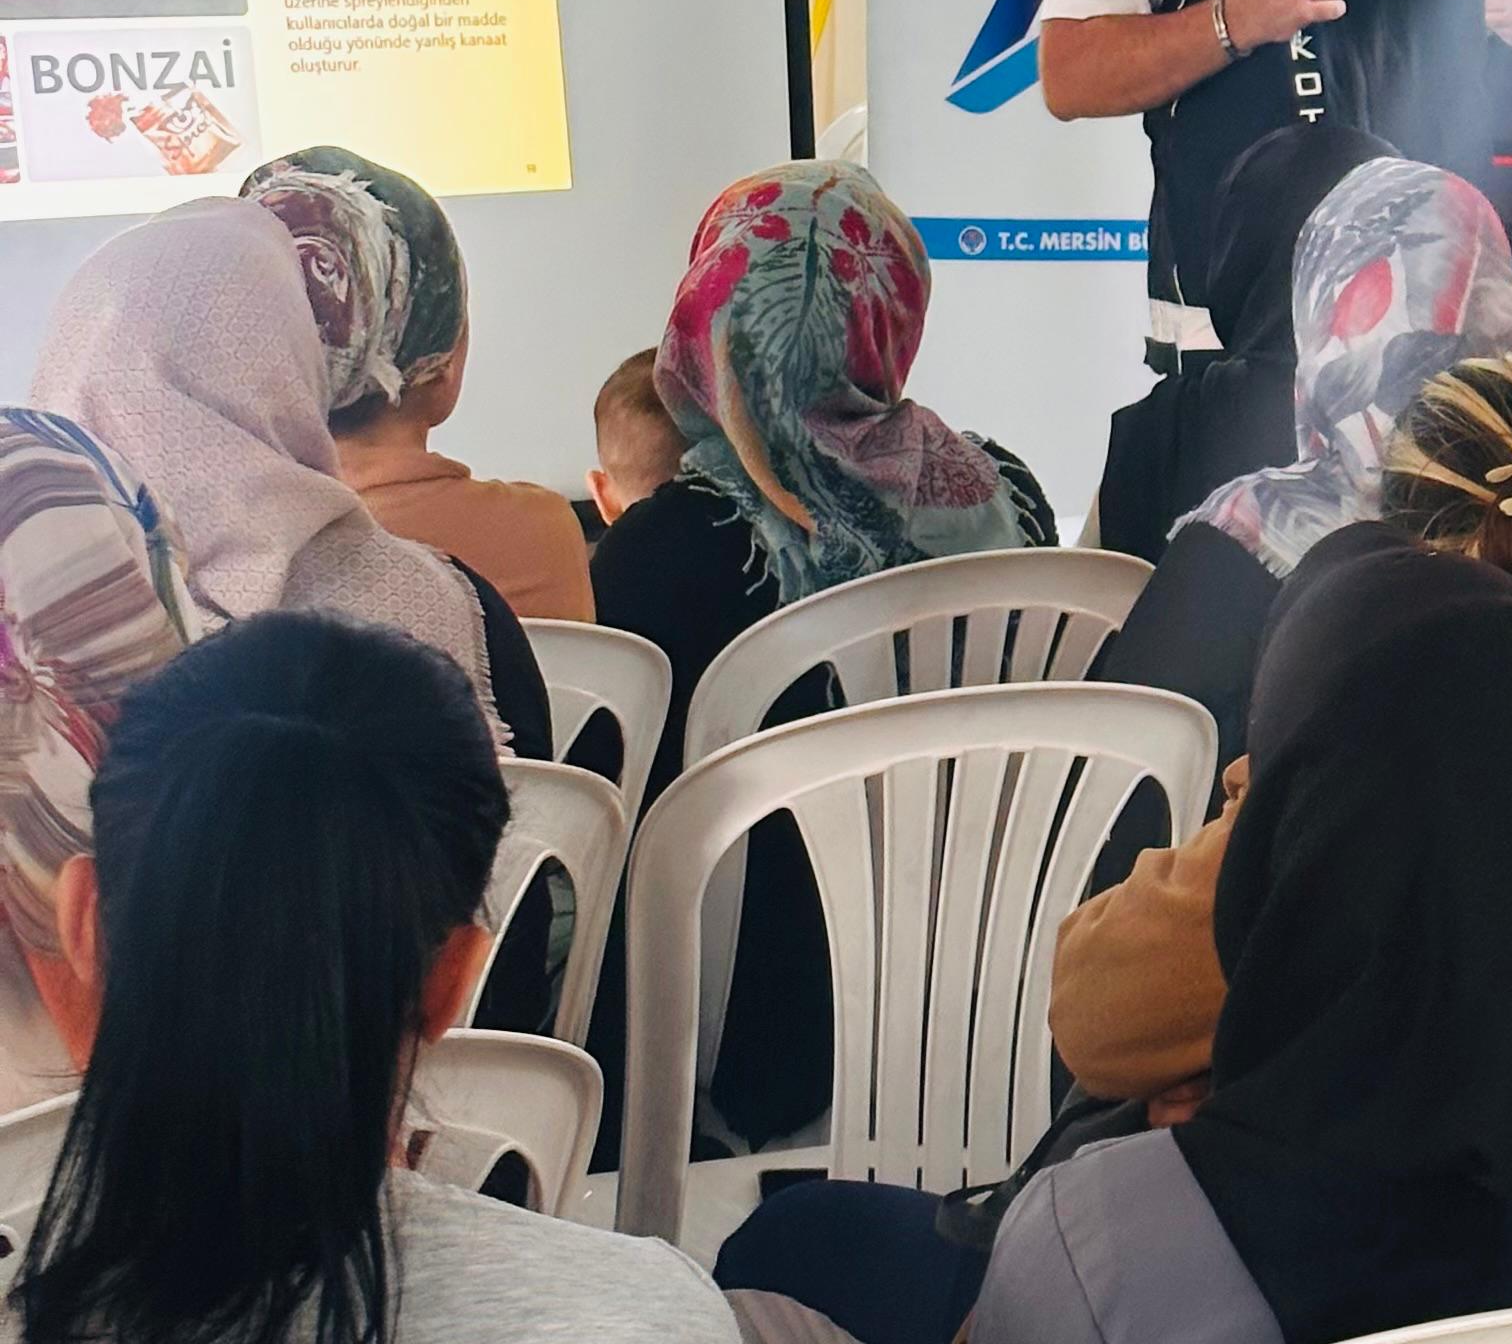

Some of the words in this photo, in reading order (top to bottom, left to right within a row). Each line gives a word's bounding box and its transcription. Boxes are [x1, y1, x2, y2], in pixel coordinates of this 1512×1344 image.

[286, 14, 384, 30] kullanıcılarda
[388, 13, 430, 32] doğal
[434, 12, 454, 27] bir
[458, 11, 508, 26] madde
[288, 36, 342, 55] olduğu
[347, 34, 411, 54] yönünde
[415, 32, 456, 52] yanlış
[460, 31, 508, 47] kanaat
[30, 38, 236, 95] BONZAİ
[998, 231, 1034, 252] T.C.
[1039, 227, 1121, 252] MERSİN
